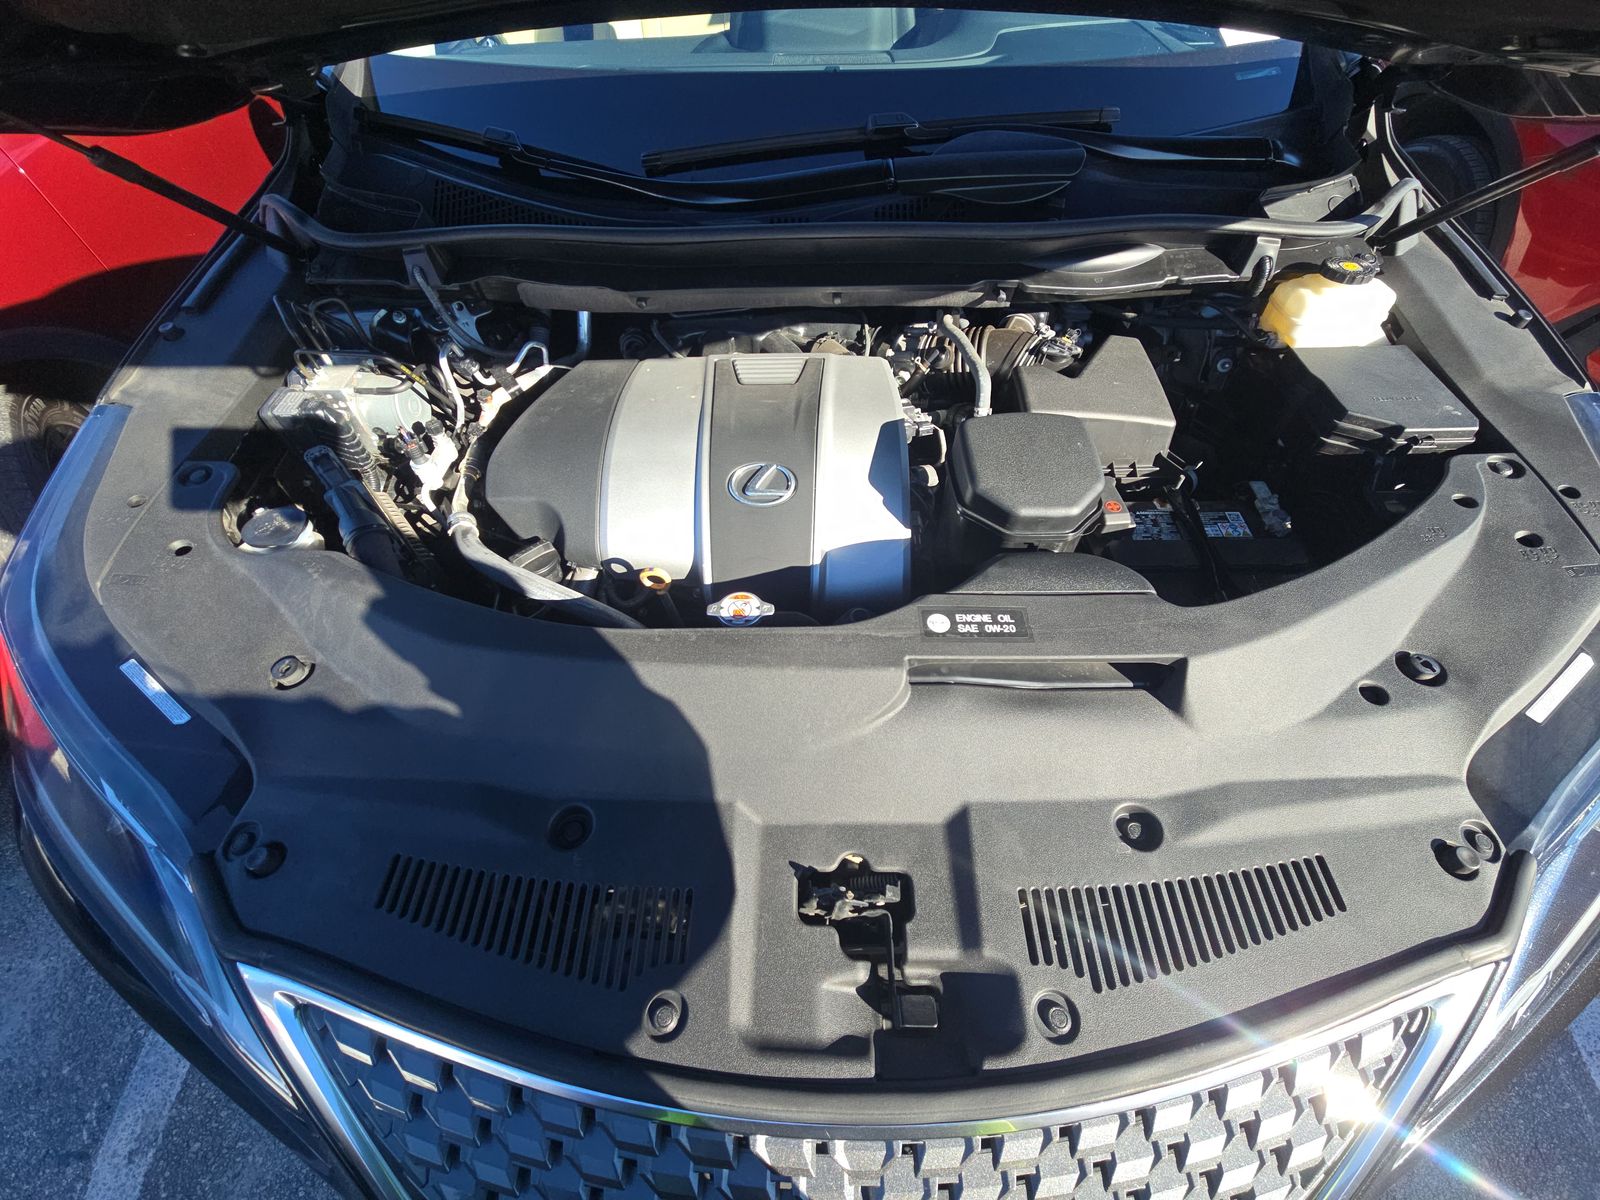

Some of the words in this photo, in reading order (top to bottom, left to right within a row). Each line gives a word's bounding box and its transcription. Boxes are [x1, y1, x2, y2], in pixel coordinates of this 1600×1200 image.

[955, 613, 993, 623] ENGINE
[997, 614, 1015, 623] OIL
[957, 624, 979, 633] SAE
[984, 624, 1017, 633] 0W-20
